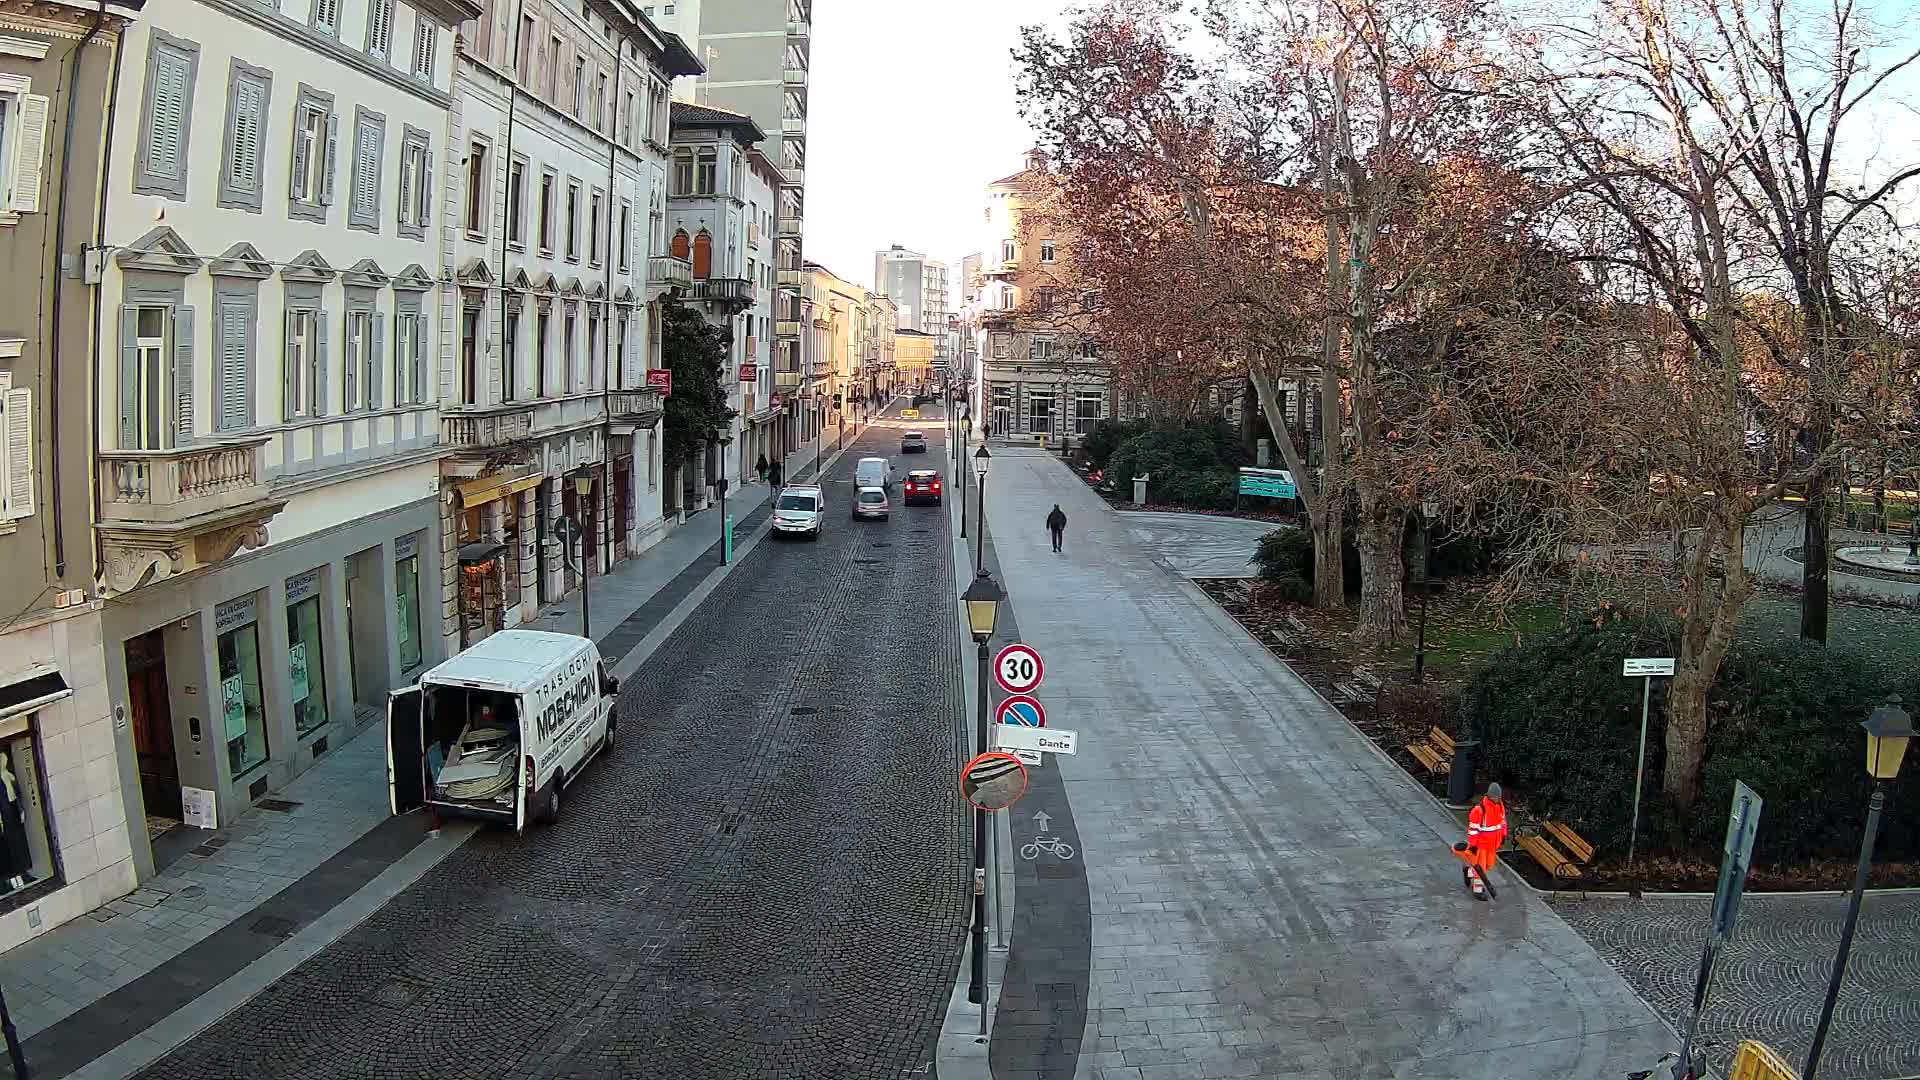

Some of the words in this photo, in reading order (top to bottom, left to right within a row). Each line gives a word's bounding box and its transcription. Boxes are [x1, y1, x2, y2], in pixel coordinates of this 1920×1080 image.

[536, 651, 591, 702] TRASLOCHI
[1006, 658, 1033, 680] 30
[536, 671, 596, 743] MOSCHION
[1039, 738, 1070, 749] Dante
